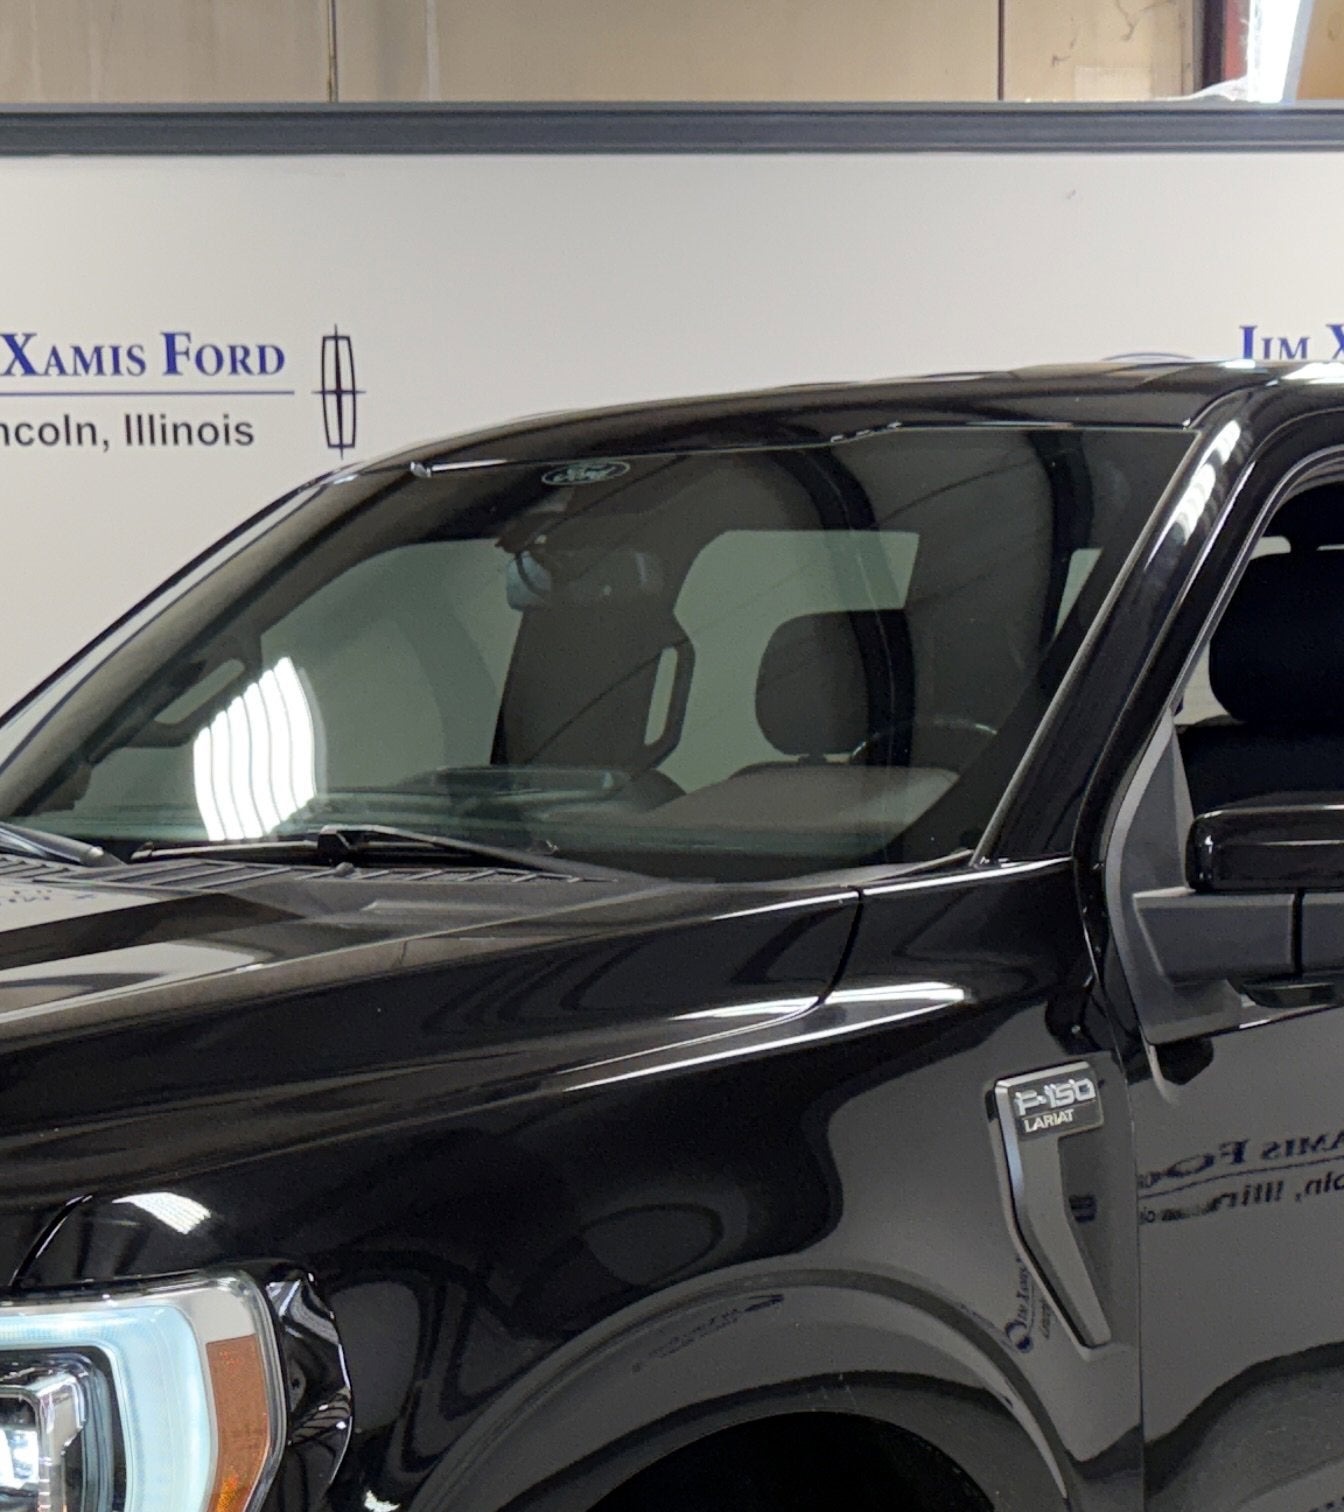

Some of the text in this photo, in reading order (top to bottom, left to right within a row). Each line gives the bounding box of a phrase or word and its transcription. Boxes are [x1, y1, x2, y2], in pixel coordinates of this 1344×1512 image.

[160, 331, 286, 377] FORD
[124, 413, 255, 448] Illinois
[1013, 1078, 1097, 1116] F-150
[1022, 1109, 1074, 1133] LARIAT
